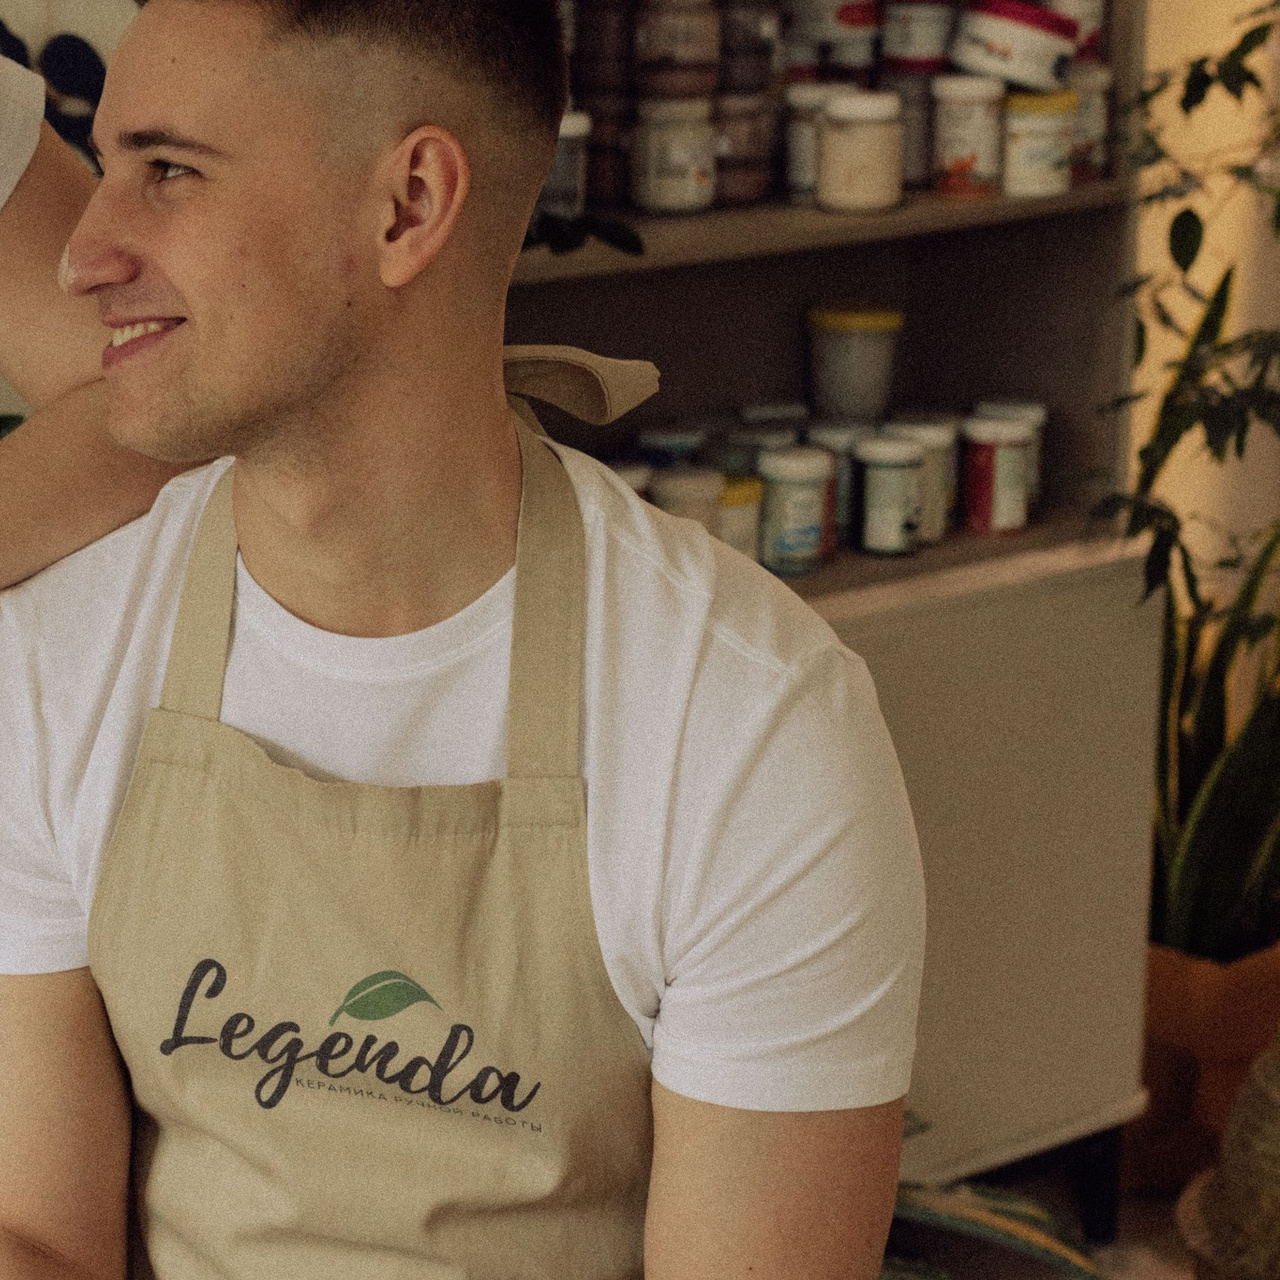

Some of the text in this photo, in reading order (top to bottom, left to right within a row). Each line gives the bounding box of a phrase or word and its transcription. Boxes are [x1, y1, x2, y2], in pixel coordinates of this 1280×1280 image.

[160, 958, 541, 1112] Legenda
[295, 1078, 387, 1101] КЕРАМИКА
[472, 1111, 542, 1133] РАБОТЫ
